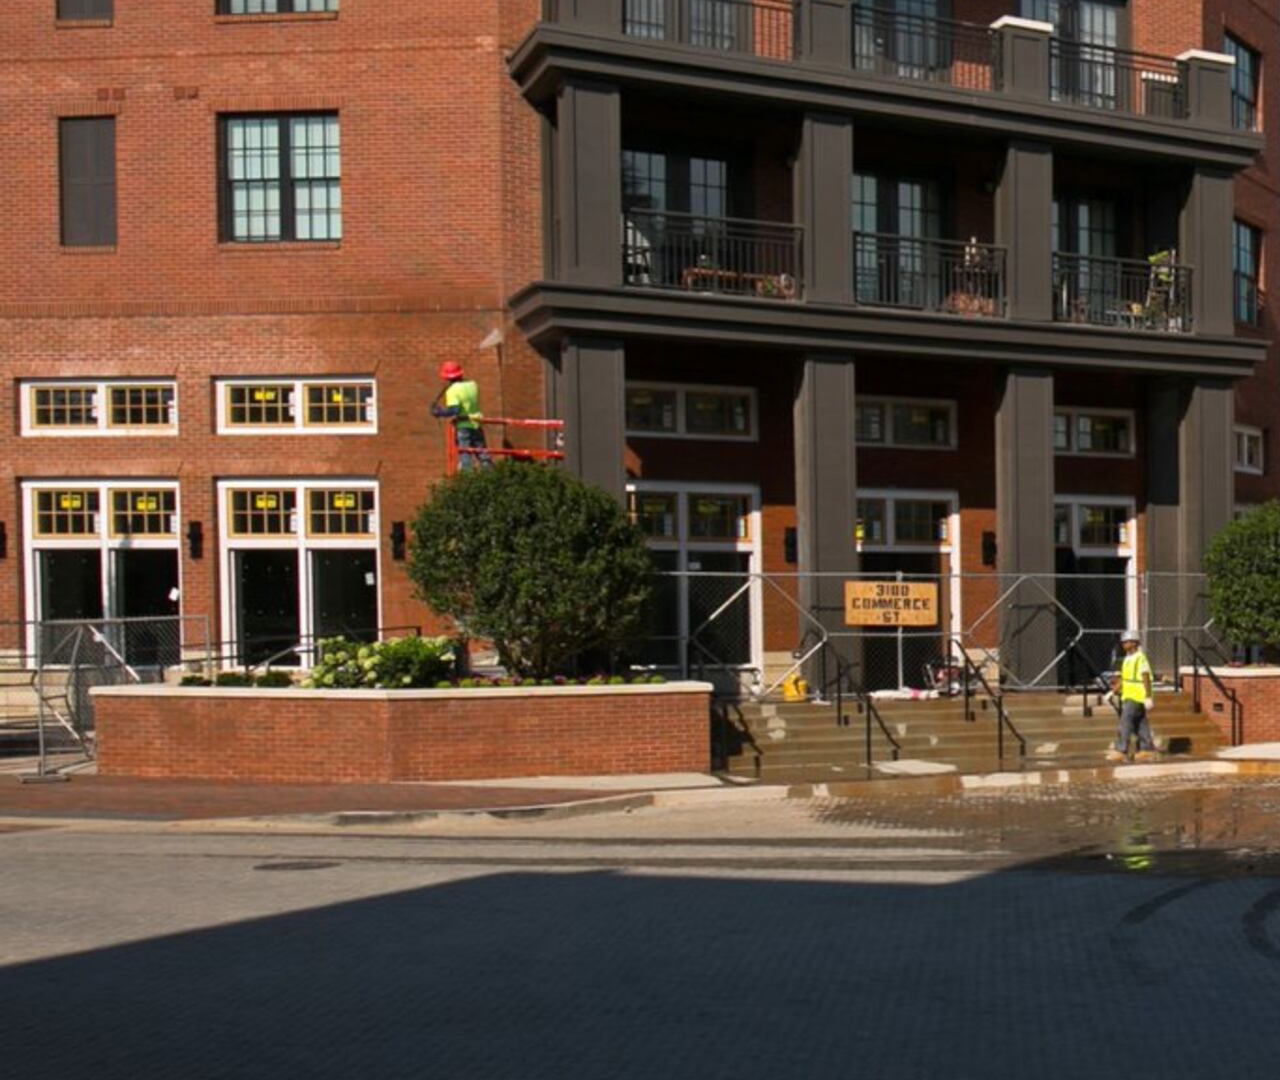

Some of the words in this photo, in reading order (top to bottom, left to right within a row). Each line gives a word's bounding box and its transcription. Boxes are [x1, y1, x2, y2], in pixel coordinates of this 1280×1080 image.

[876, 584, 909, 596] 3100
[852, 597, 930, 610] COMMERCE
[882, 611, 900, 622] ST
